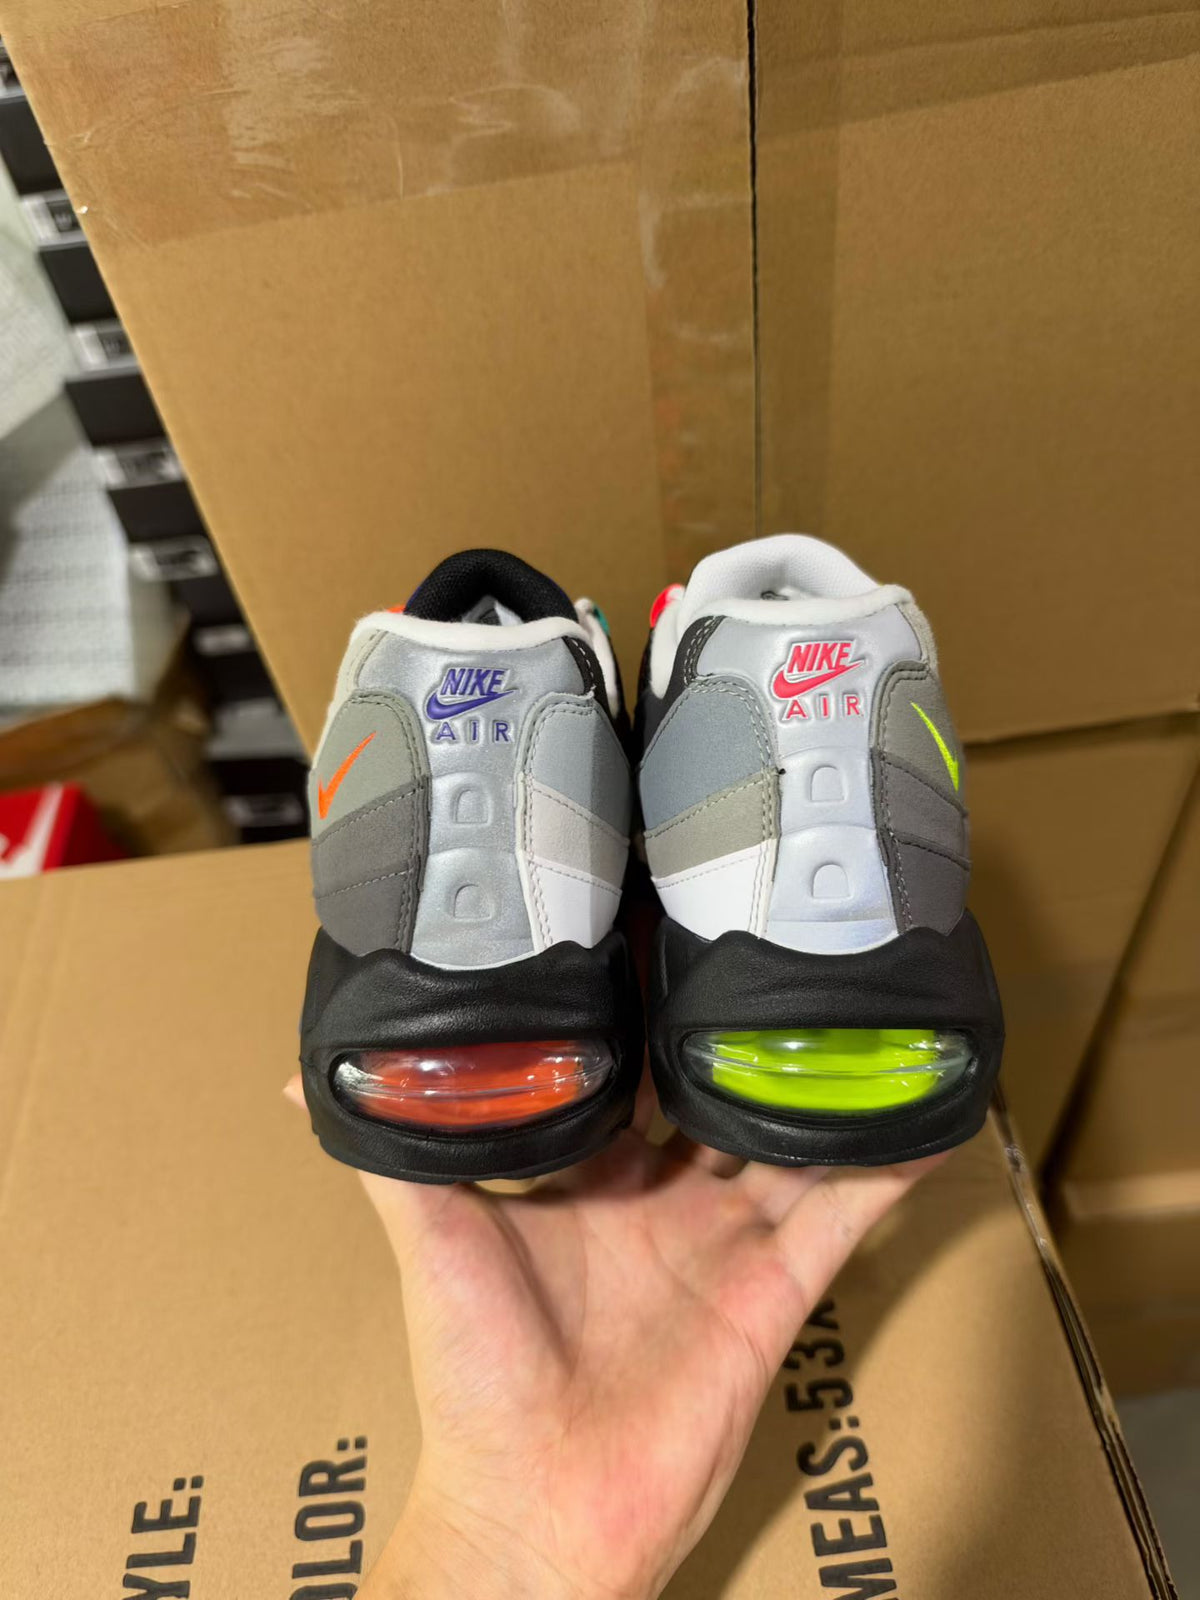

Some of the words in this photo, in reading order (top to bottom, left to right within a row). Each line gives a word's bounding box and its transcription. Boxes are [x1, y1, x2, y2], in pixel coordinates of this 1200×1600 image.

[787, 642, 852, 674] NIKE
[440, 668, 506, 696] NIKE
[786, 695, 860, 719] AIR
[436, 721, 509, 742] AIR
